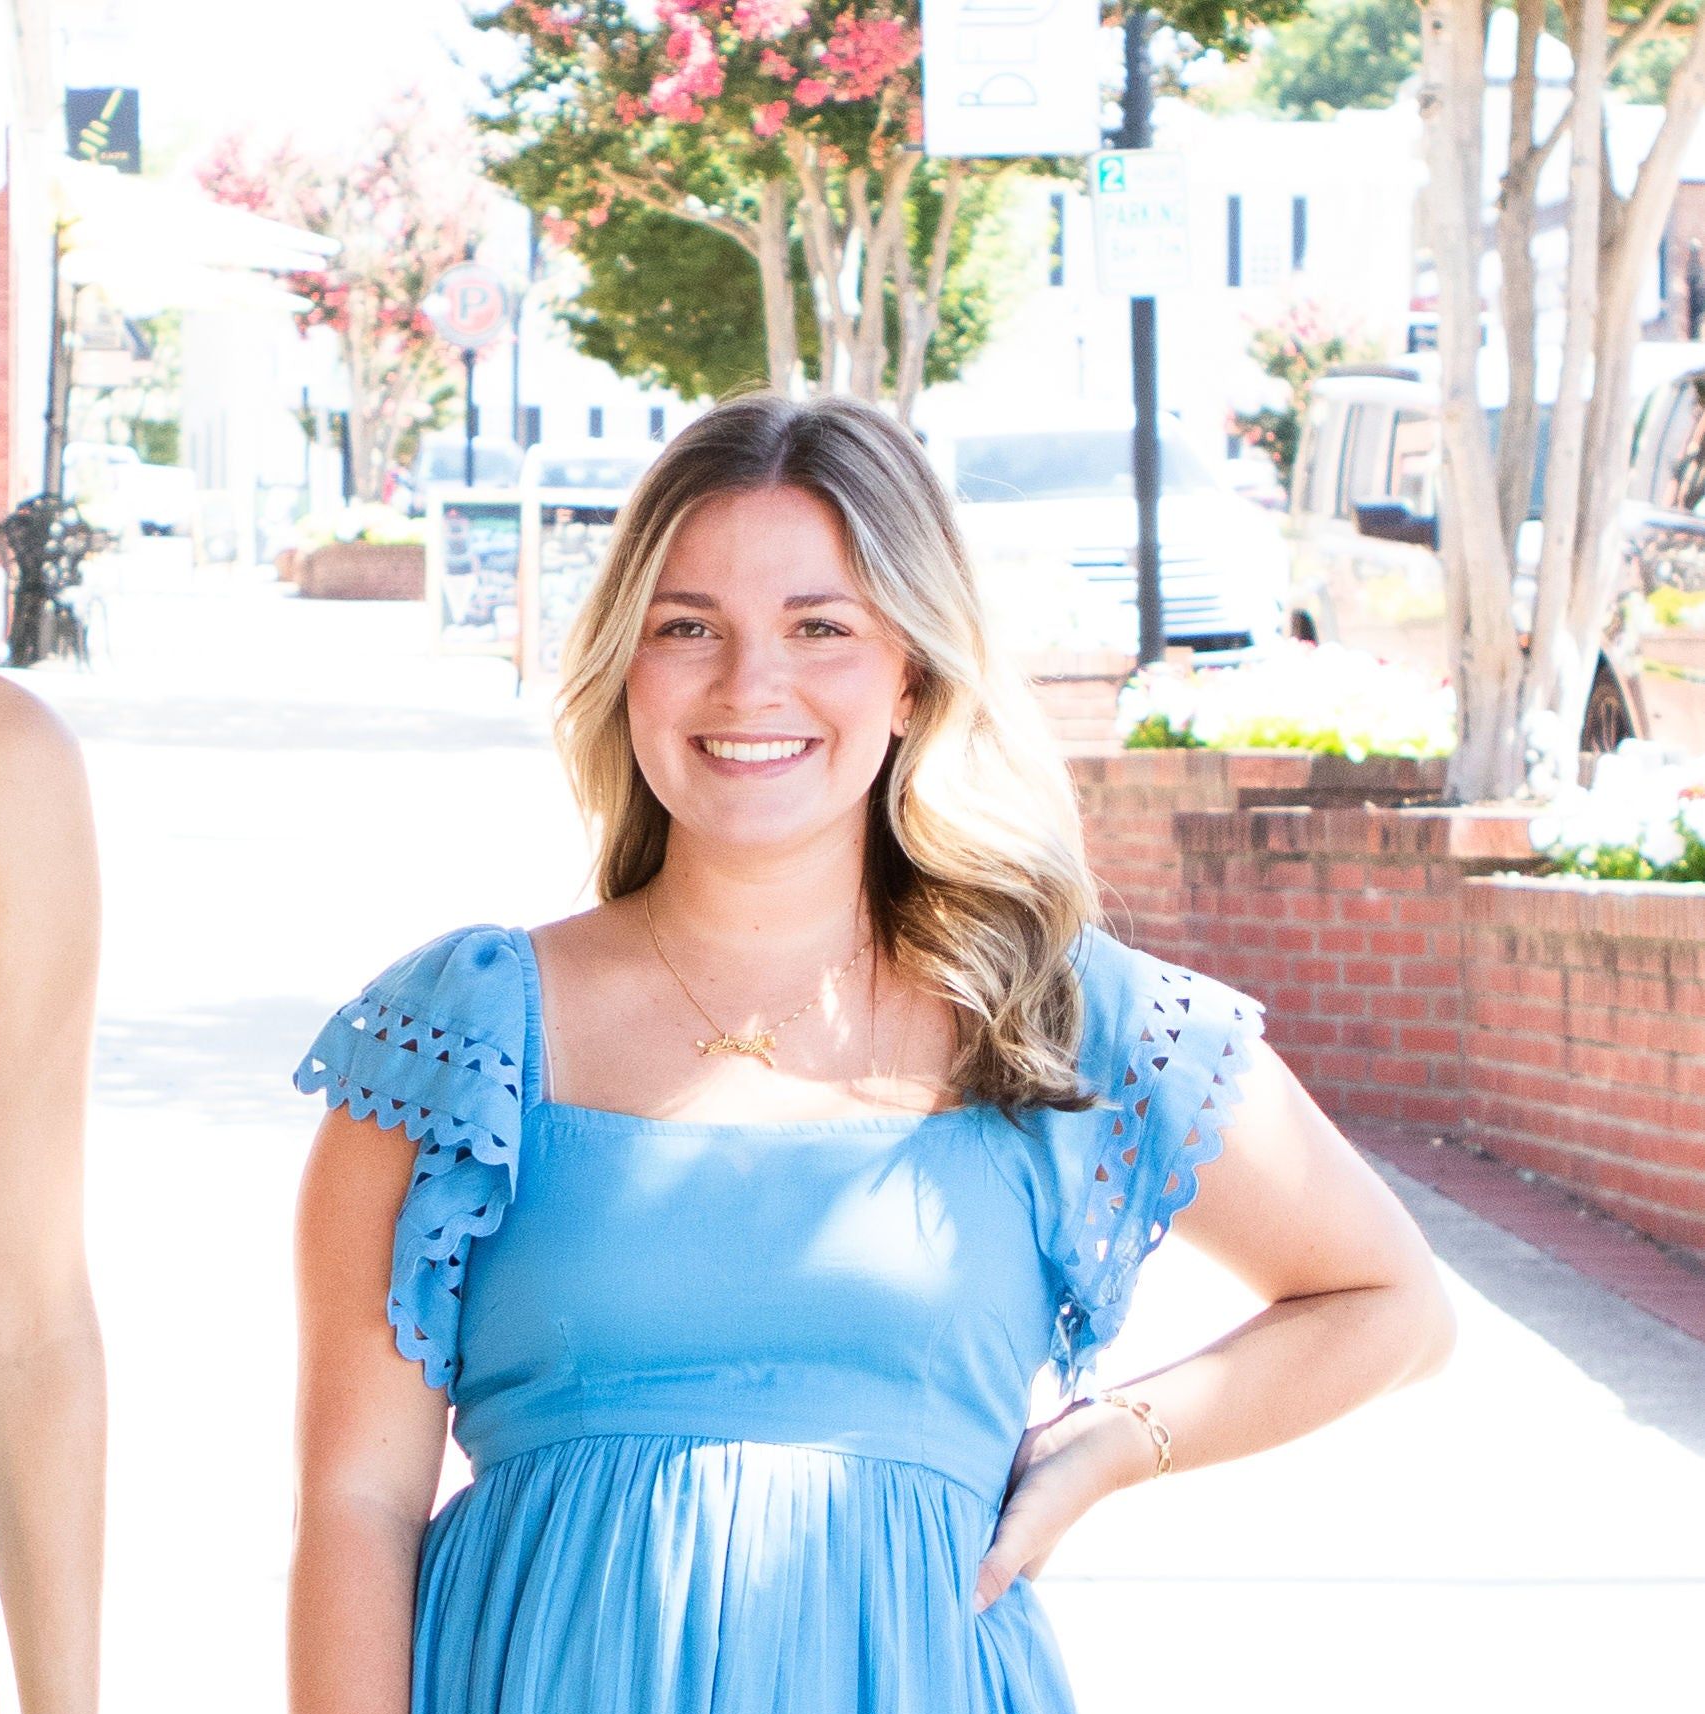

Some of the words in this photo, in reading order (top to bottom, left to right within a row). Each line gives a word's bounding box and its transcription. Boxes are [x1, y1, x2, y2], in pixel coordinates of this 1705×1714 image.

[1103, 160, 1122, 191] 2
[1104, 200, 1183, 227] PARKING
[460, 287, 489, 320] P
